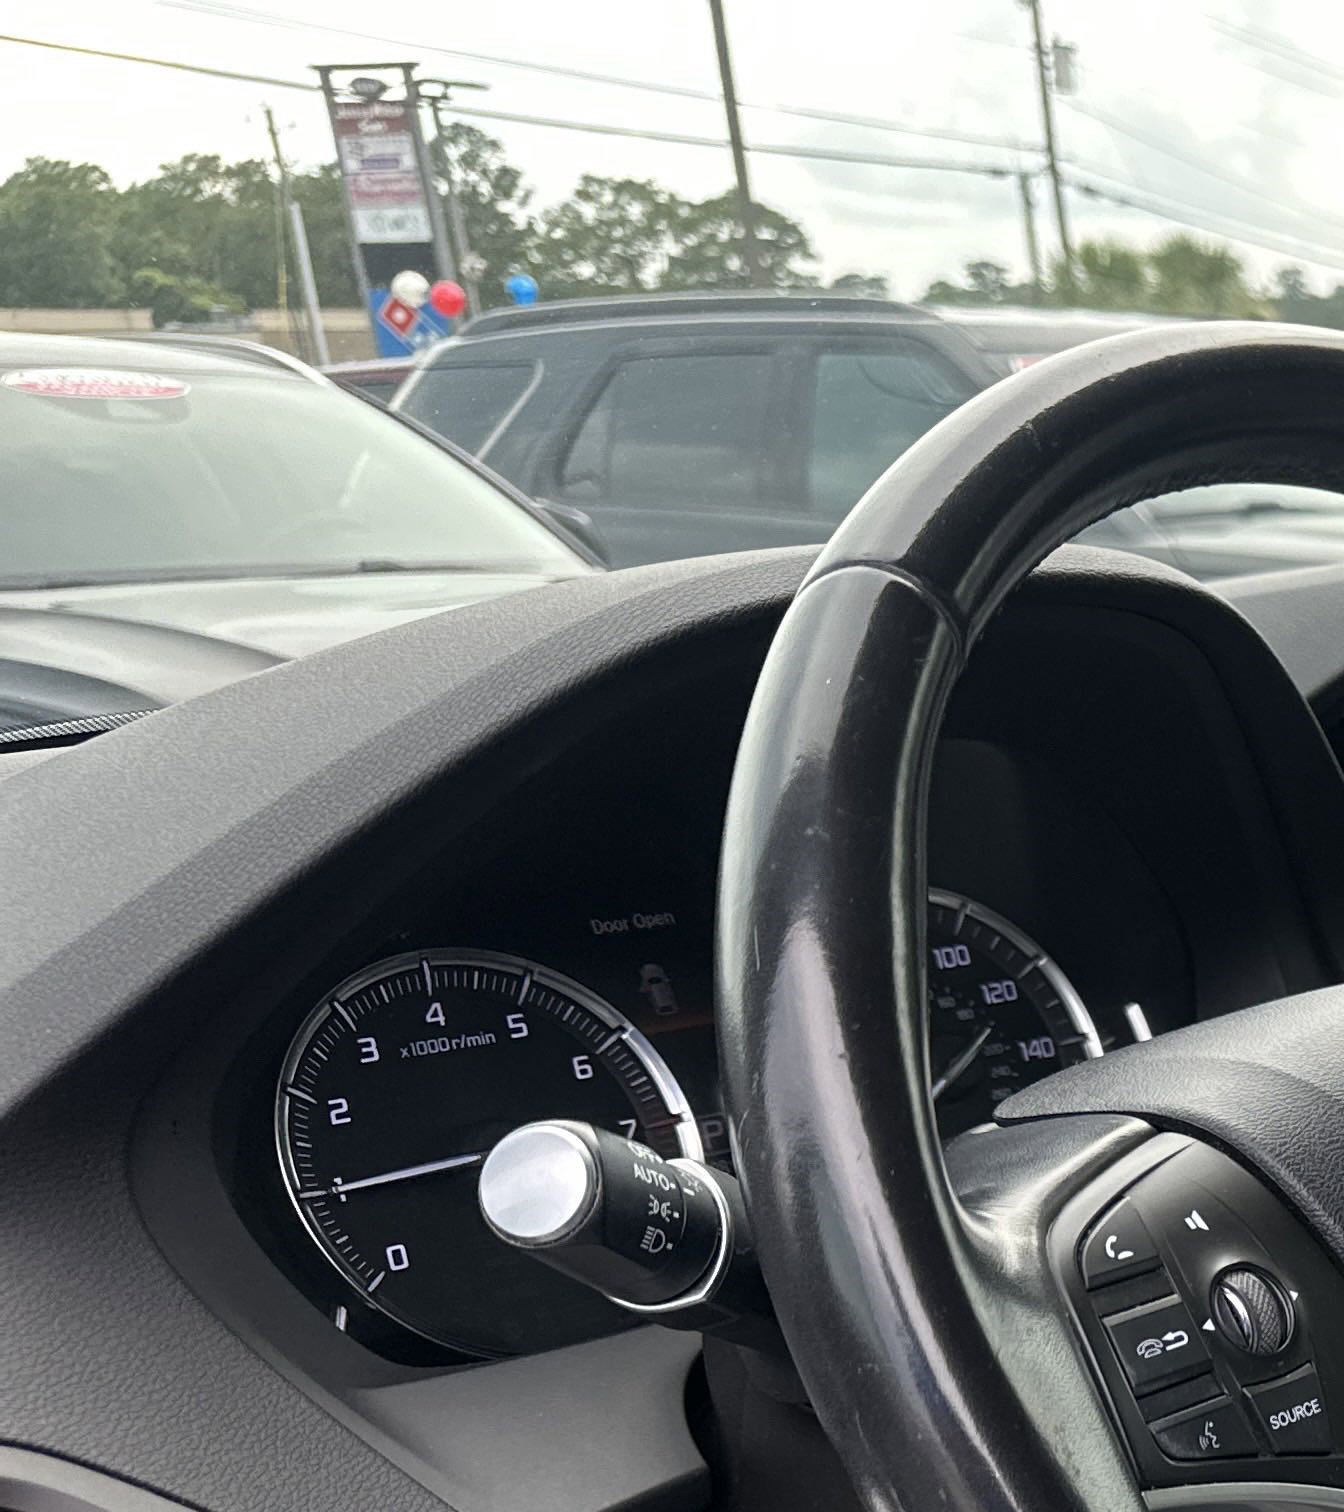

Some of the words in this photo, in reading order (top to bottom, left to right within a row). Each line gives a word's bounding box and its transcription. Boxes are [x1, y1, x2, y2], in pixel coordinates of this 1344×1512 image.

[591, 918, 630, 935] Door
[632, 911, 677, 929] Open
[933, 944, 971, 969] 100
[979, 980, 1018, 1005] 120
[425, 1002, 446, 1026] 4
[506, 1013, 529, 1038] 5
[357, 1036, 380, 1064] 3
[1016, 1037, 1056, 1062] 140
[572, 1055, 594, 1080] 6
[328, 1098, 351, 1126] 2
[618, 1118, 637, 1139] 7
[701, 1119, 725, 1150] P
[633, 1162, 670, 1191] AUTO
[386, 1244, 410, 1271] 0
[1269, 1398, 1322, 1431] SOURCE
